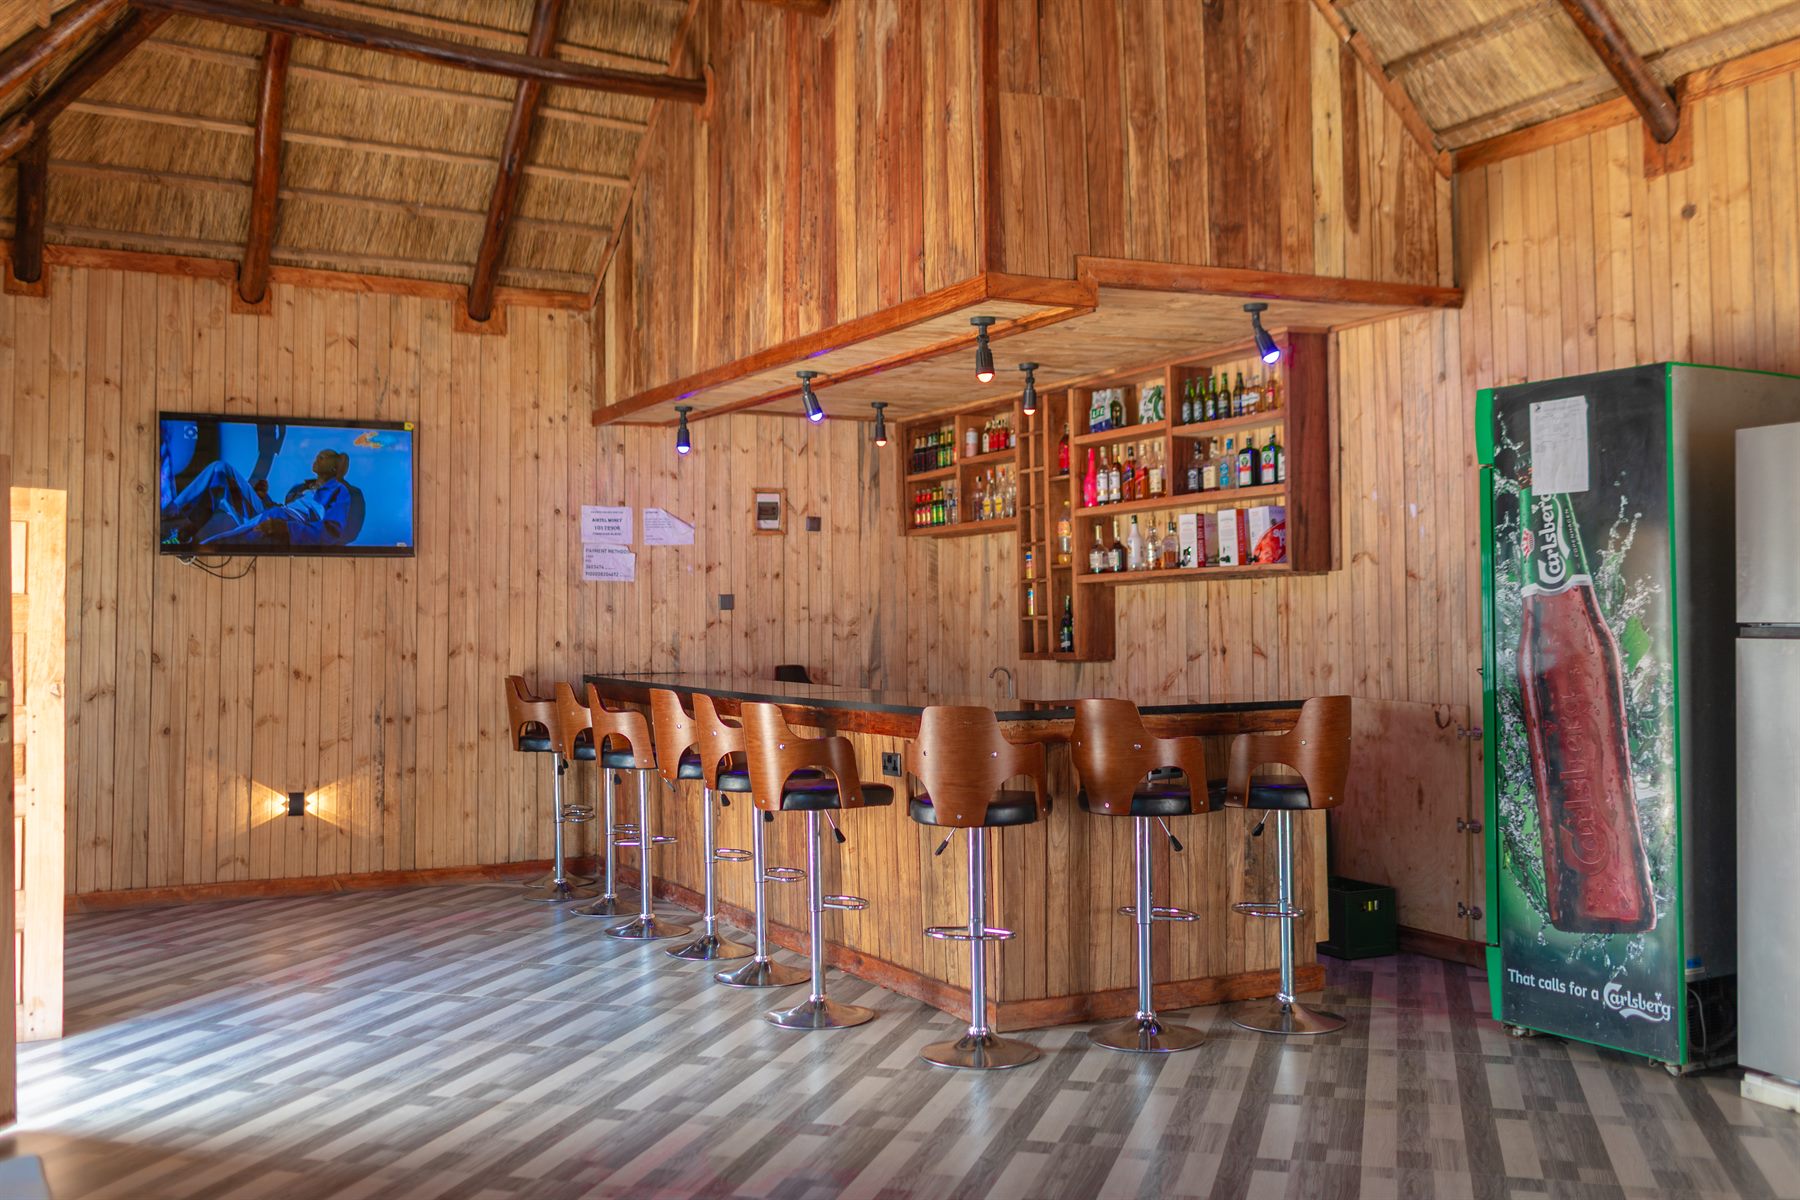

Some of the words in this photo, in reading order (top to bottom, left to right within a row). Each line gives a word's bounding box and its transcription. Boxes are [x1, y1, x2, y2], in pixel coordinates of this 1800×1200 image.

[1507, 968, 1536, 988] That
[1538, 978, 1566, 994] calls
[1569, 981, 1588, 998] for
[1591, 989, 1600, 1001] a
[1603, 981, 1672, 1023] Carlsberg
